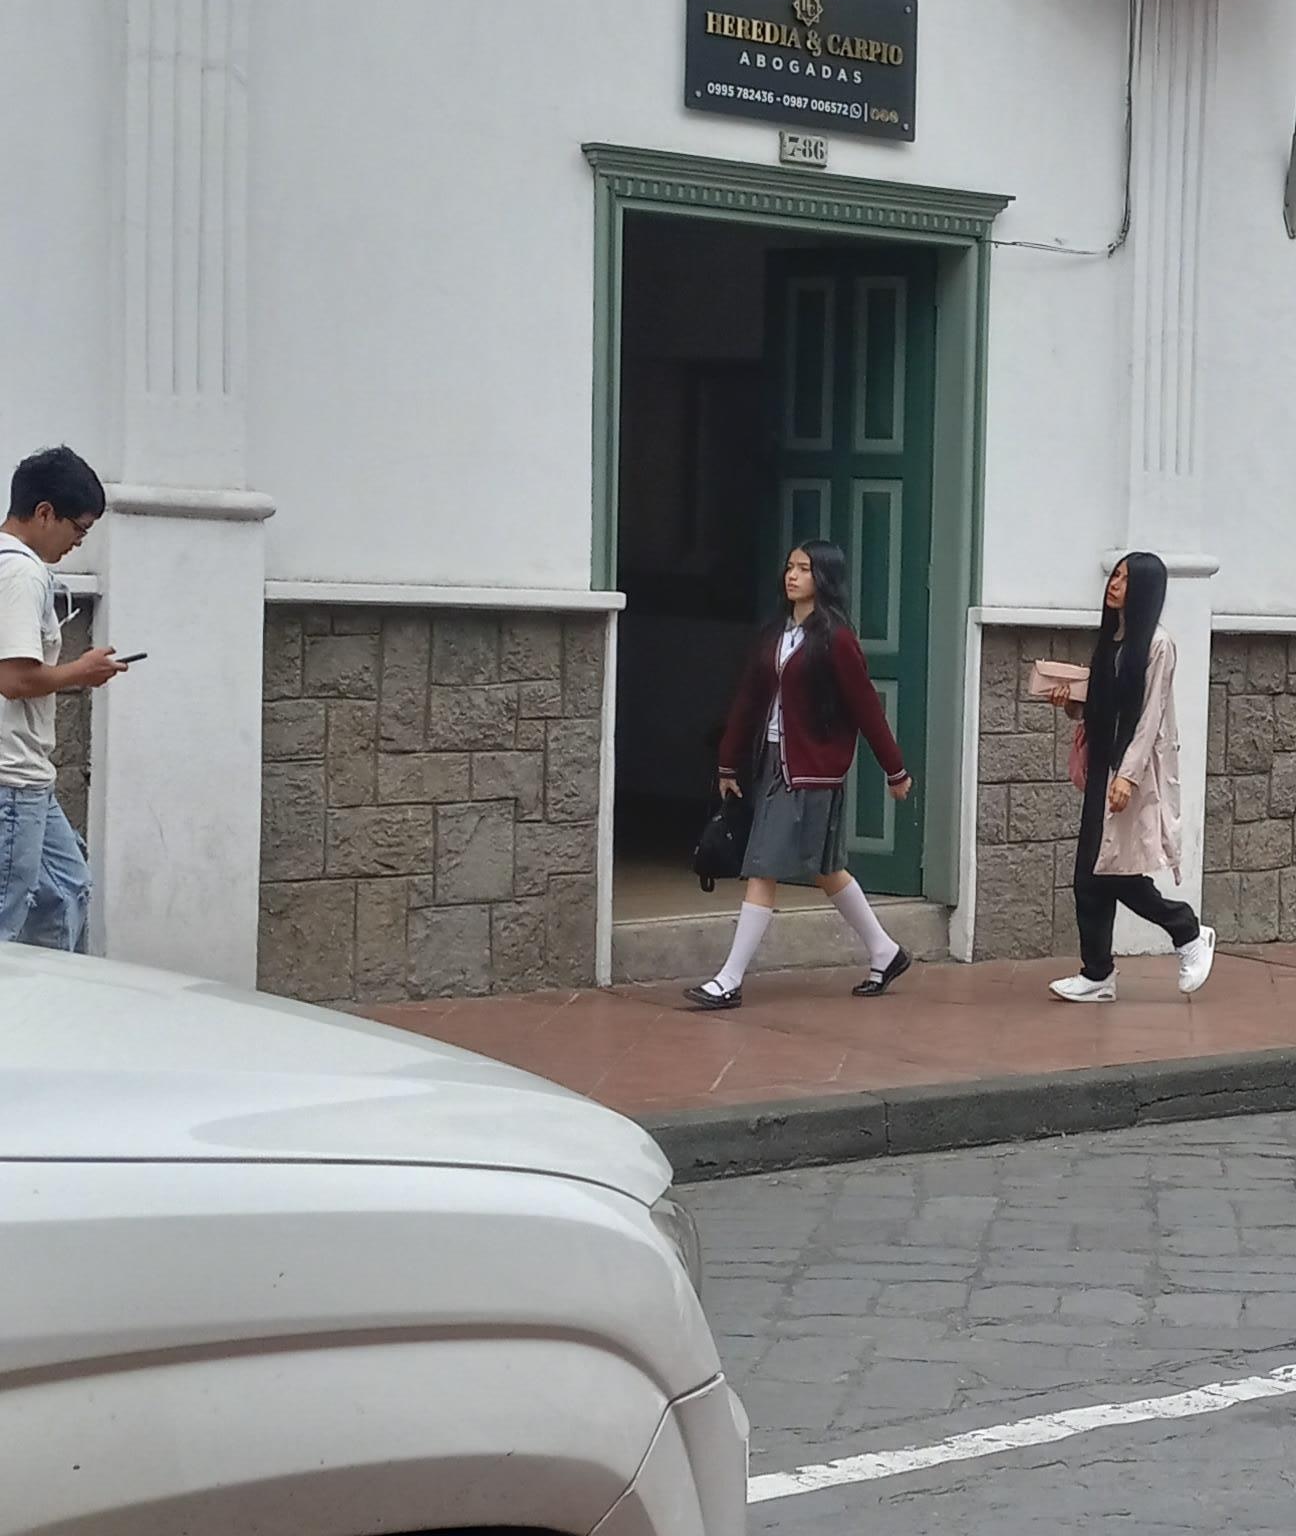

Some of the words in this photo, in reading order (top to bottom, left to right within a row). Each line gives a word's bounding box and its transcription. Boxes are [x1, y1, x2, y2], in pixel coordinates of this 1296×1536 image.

[706, 11, 801, 49] HEREDIA
[806, 29, 822, 57] &
[827, 33, 904, 66] CARPIO
[739, 51, 863, 84] ABOGADAS
[707, 82, 734, 97] 0995
[736, 86, 774, 104] 782436
[782, 94, 809, 109] 0987
[810, 99, 849, 116] 006572
